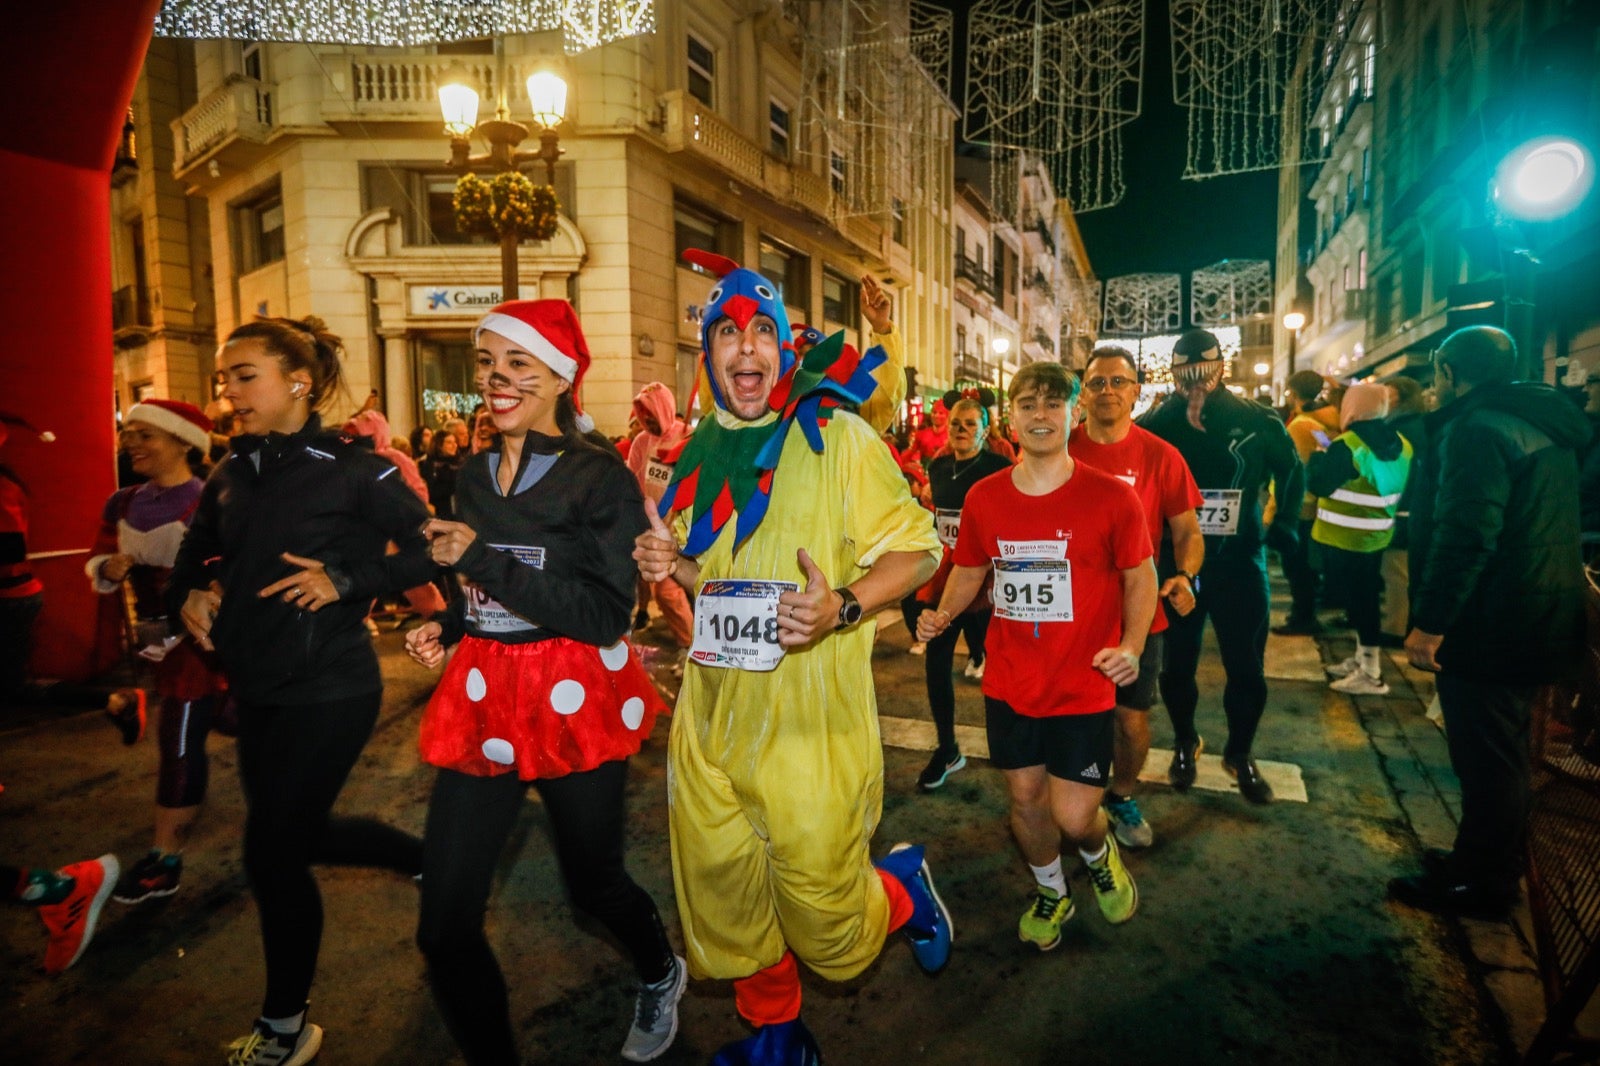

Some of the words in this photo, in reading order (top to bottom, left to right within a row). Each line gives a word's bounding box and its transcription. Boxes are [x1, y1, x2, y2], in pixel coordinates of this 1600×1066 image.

[648, 466, 669, 481] 628
[1003, 544, 1016, 556] 30
[1003, 582, 1054, 605] 915
[709, 613, 780, 645] 1048
[741, 647, 759, 656] TOLEDO
